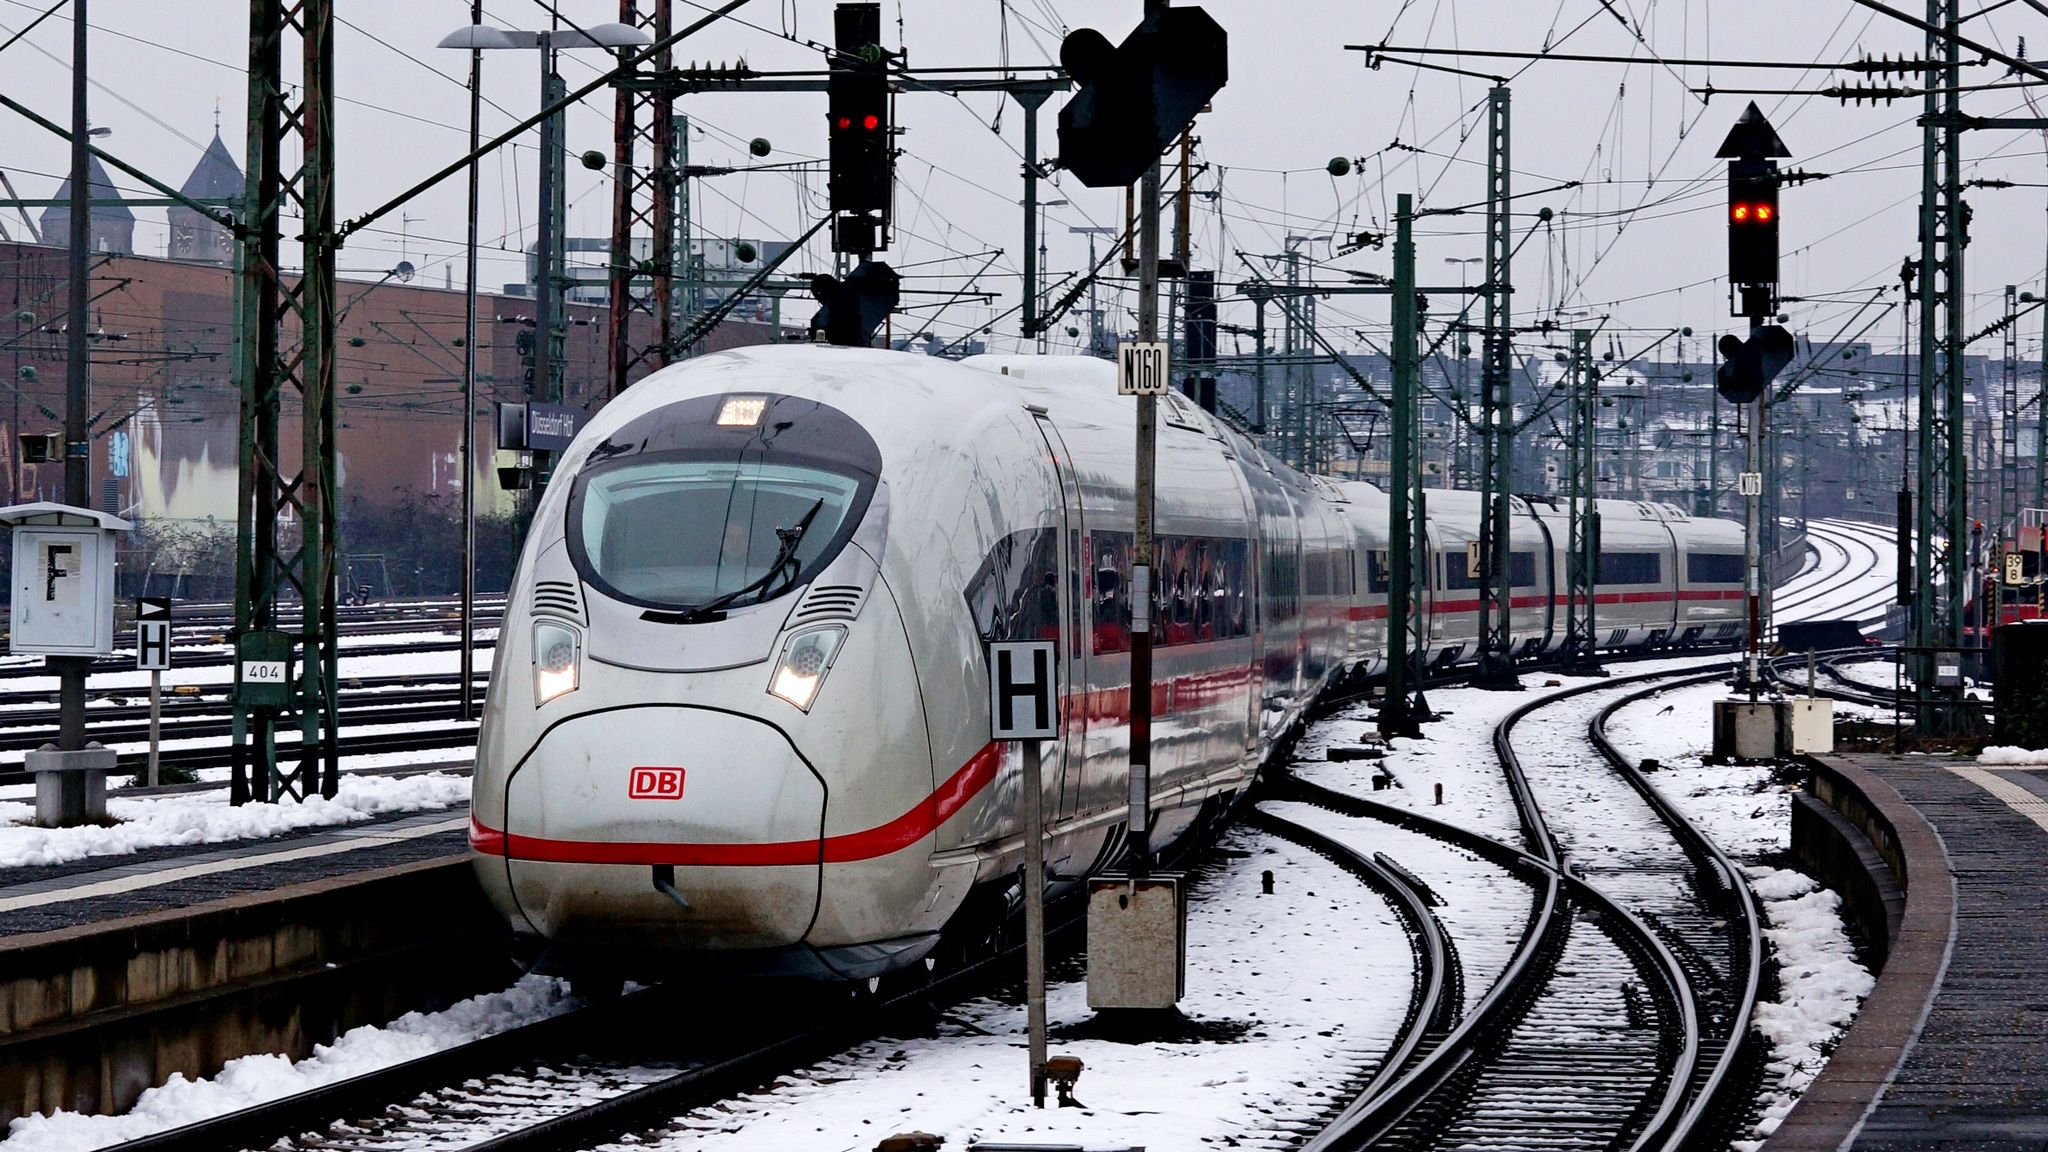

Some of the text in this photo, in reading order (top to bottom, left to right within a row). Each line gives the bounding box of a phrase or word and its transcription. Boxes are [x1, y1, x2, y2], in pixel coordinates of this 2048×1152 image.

[1124, 348, 1162, 390] N160
[531, 410, 574, 437] Düsseldorf Hbf
[46, 545, 72, 601] F
[2007, 556, 2021, 568] 39
[2010, 569, 2018, 580] 8
[141, 624, 166, 666] H
[249, 665, 279, 679] 404
[997, 648, 1050, 731] H
[634, 770, 679, 795] DB
